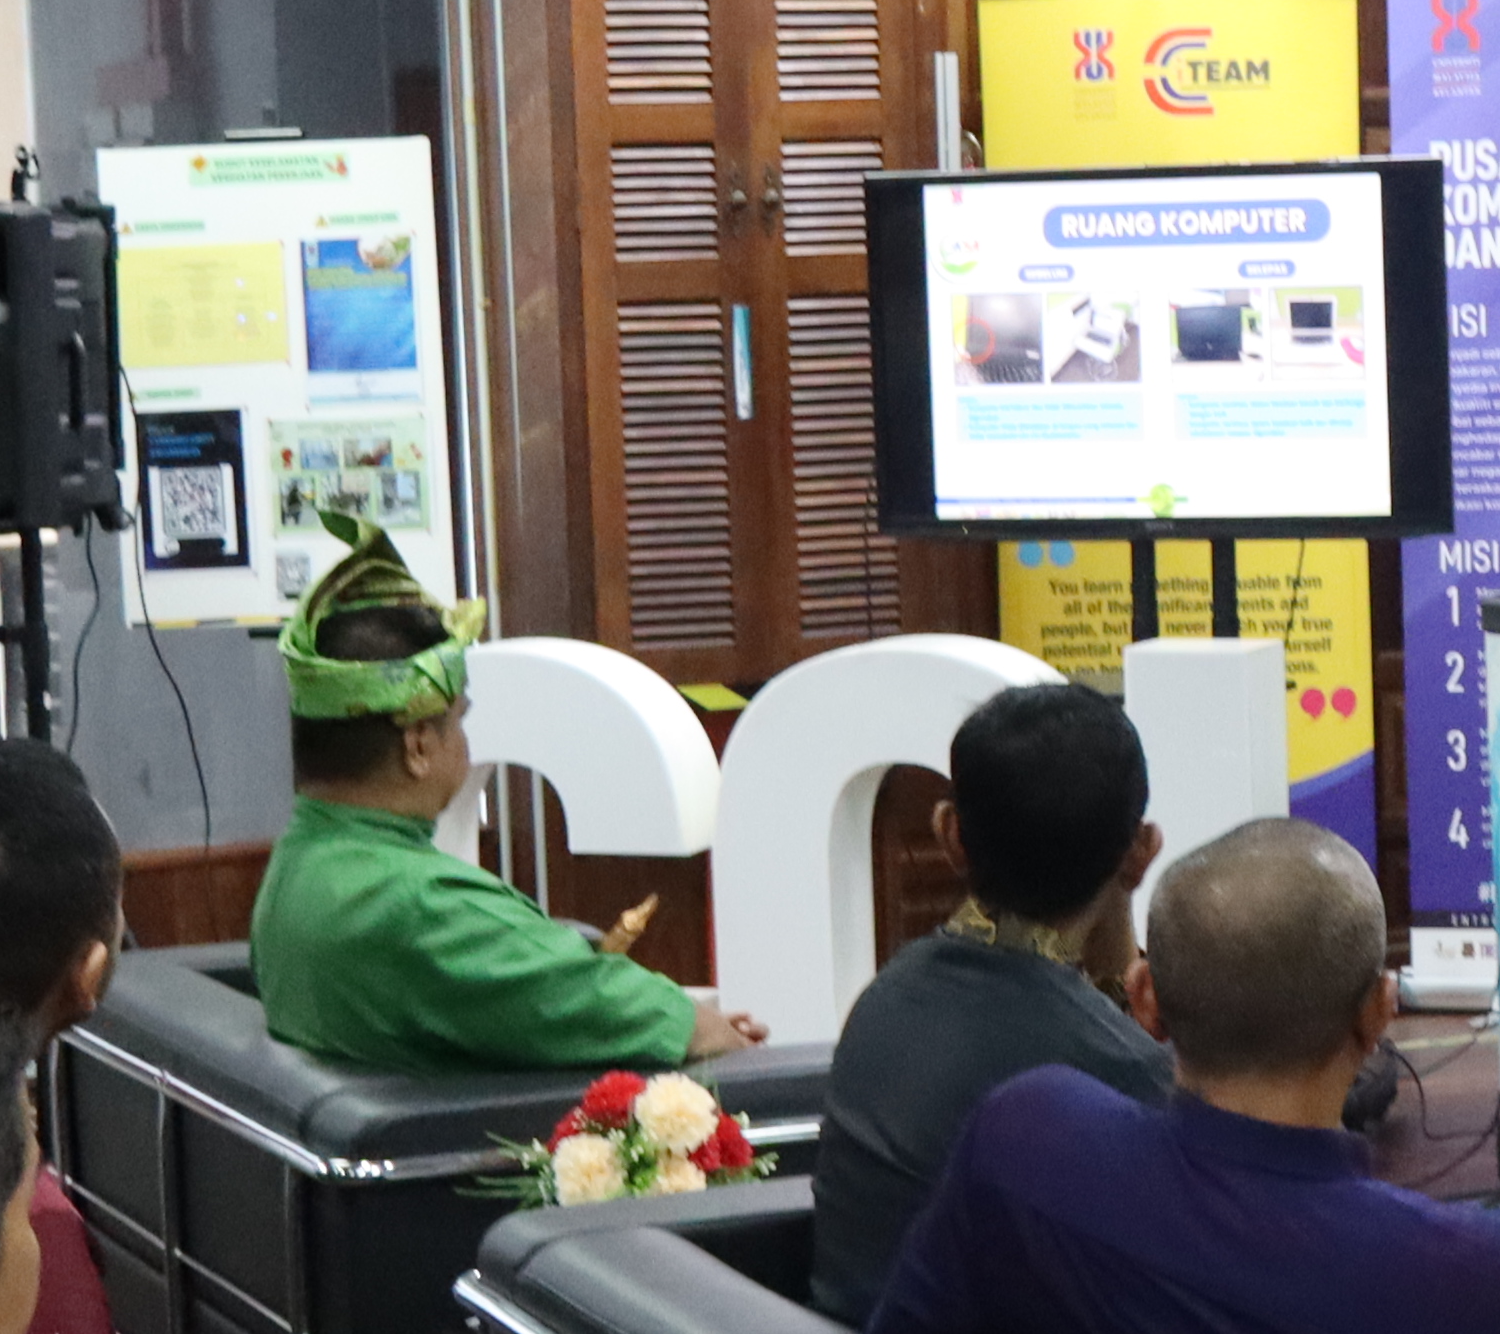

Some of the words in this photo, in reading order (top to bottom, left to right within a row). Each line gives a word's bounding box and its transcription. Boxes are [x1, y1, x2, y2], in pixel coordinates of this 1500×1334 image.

[1061, 211, 1156, 238] RUANG
[1161, 207, 1306, 236] KOMPUTER
[1451, 303, 1487, 338] ISI
[1439, 539, 1500, 573] MISI
[1049, 580, 1079, 595] You
[1083, 578, 1124, 595] learn
[1063, 599, 1081, 615] all
[1445, 585, 1461, 627] 1
[1102, 619, 1130, 637] but
[1166, 618, 1208, 635] never
[1301, 616, 1333, 632] true
[1445, 651, 1465, 694] 2
[1446, 729, 1467, 772] 3
[1448, 808, 1470, 850] 4
